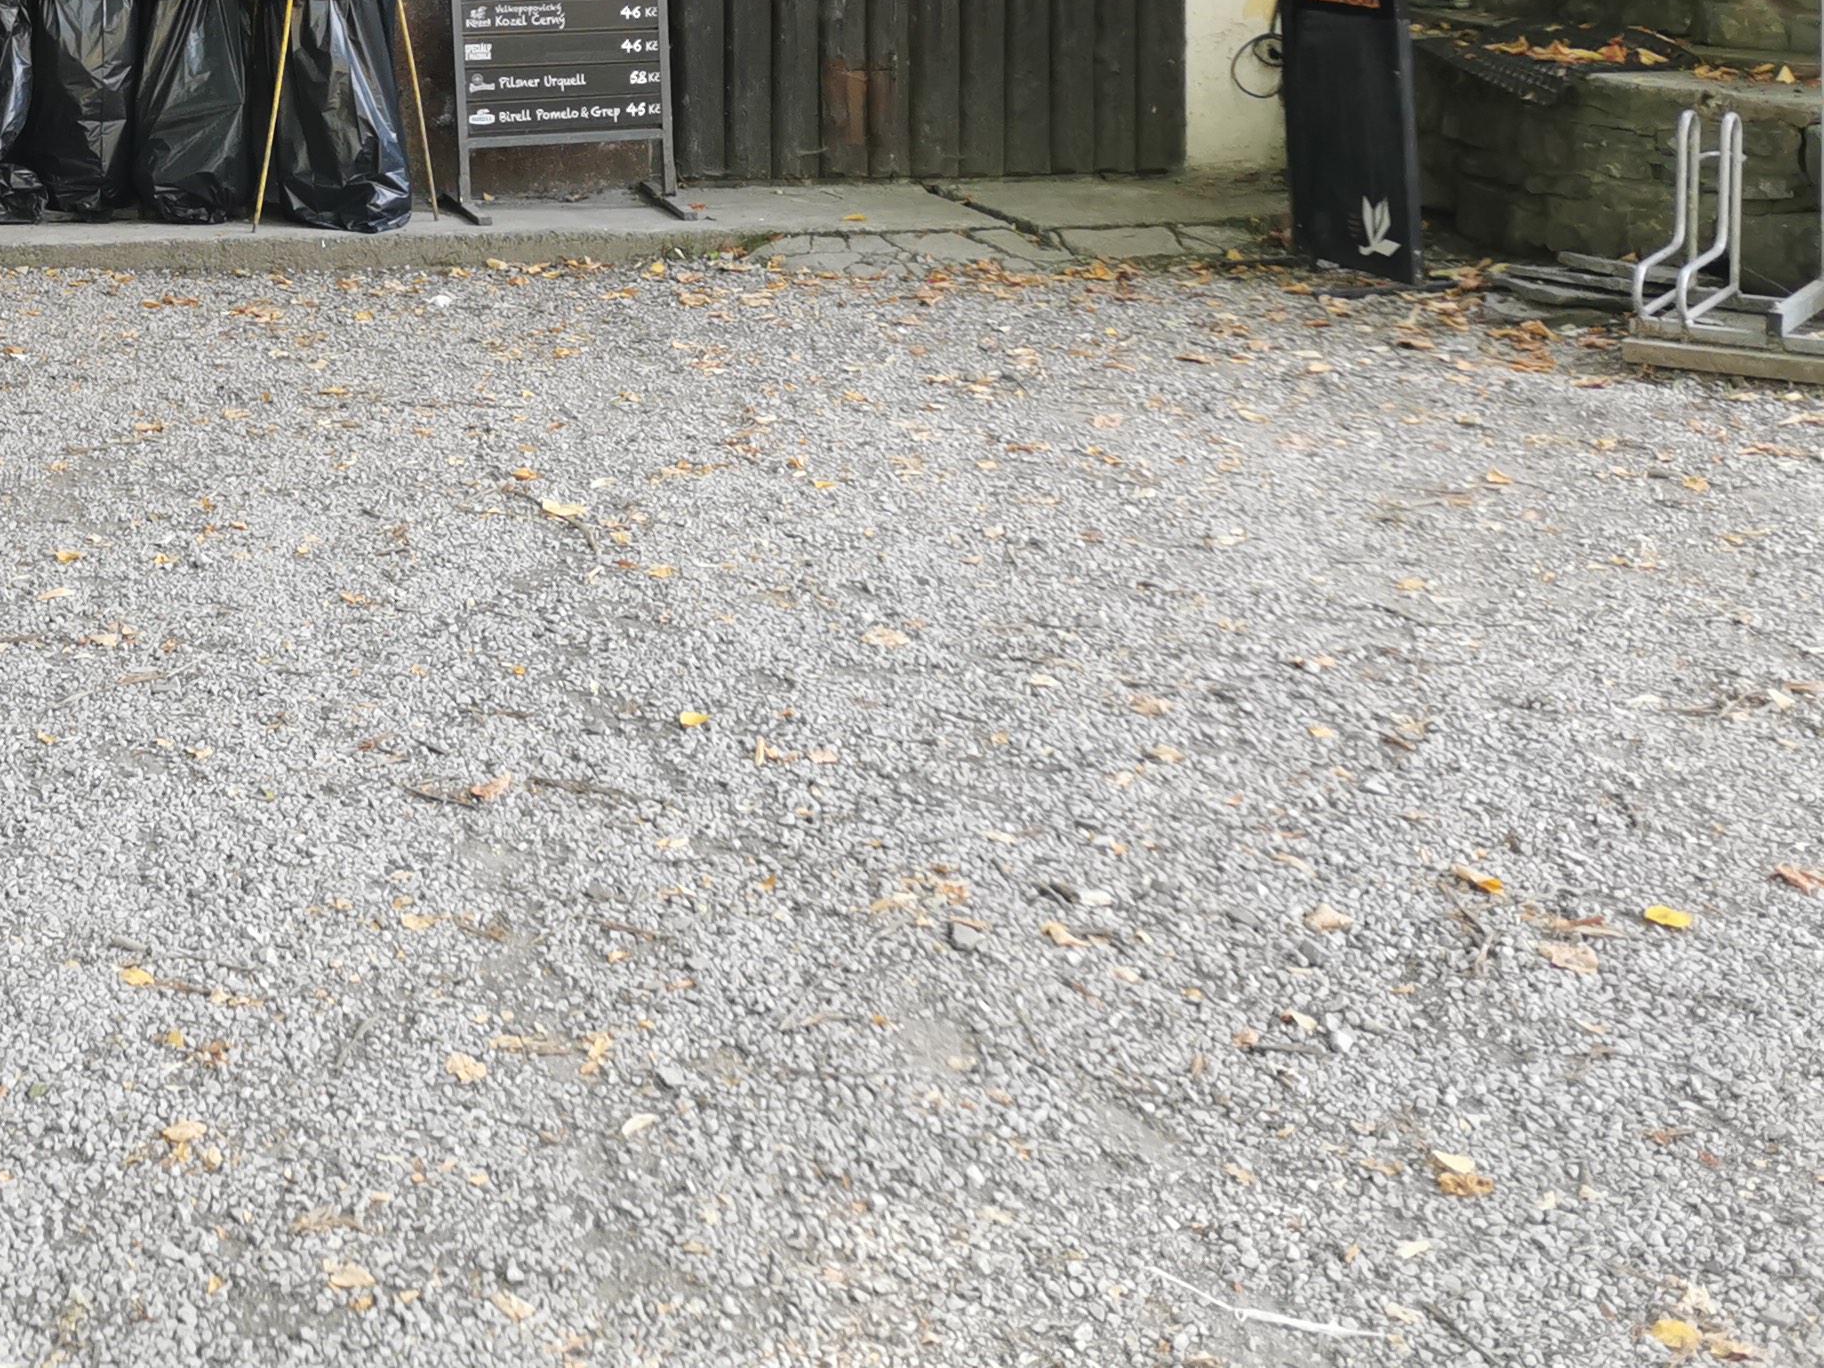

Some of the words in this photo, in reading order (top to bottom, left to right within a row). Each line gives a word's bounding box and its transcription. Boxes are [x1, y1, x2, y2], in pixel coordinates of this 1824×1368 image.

[495, 15, 527, 27] Kozel
[531, 12, 565, 30] Černý
[620, 4, 642, 20] 46
[645, 7, 658, 18] Kč
[621, 39, 642, 53] 46
[646, 40, 659, 51] Kč
[499, 77, 540, 89] Pilsner
[544, 74, 586, 92] Urquell
[648, 72, 661, 83] Kč
[499, 109, 532, 123] Birell
[536, 107, 579, 121] Pomelo
[590, 105, 621, 123] Grep
[626, 102, 646, 117] 45
[648, 103, 661, 114] Kč
